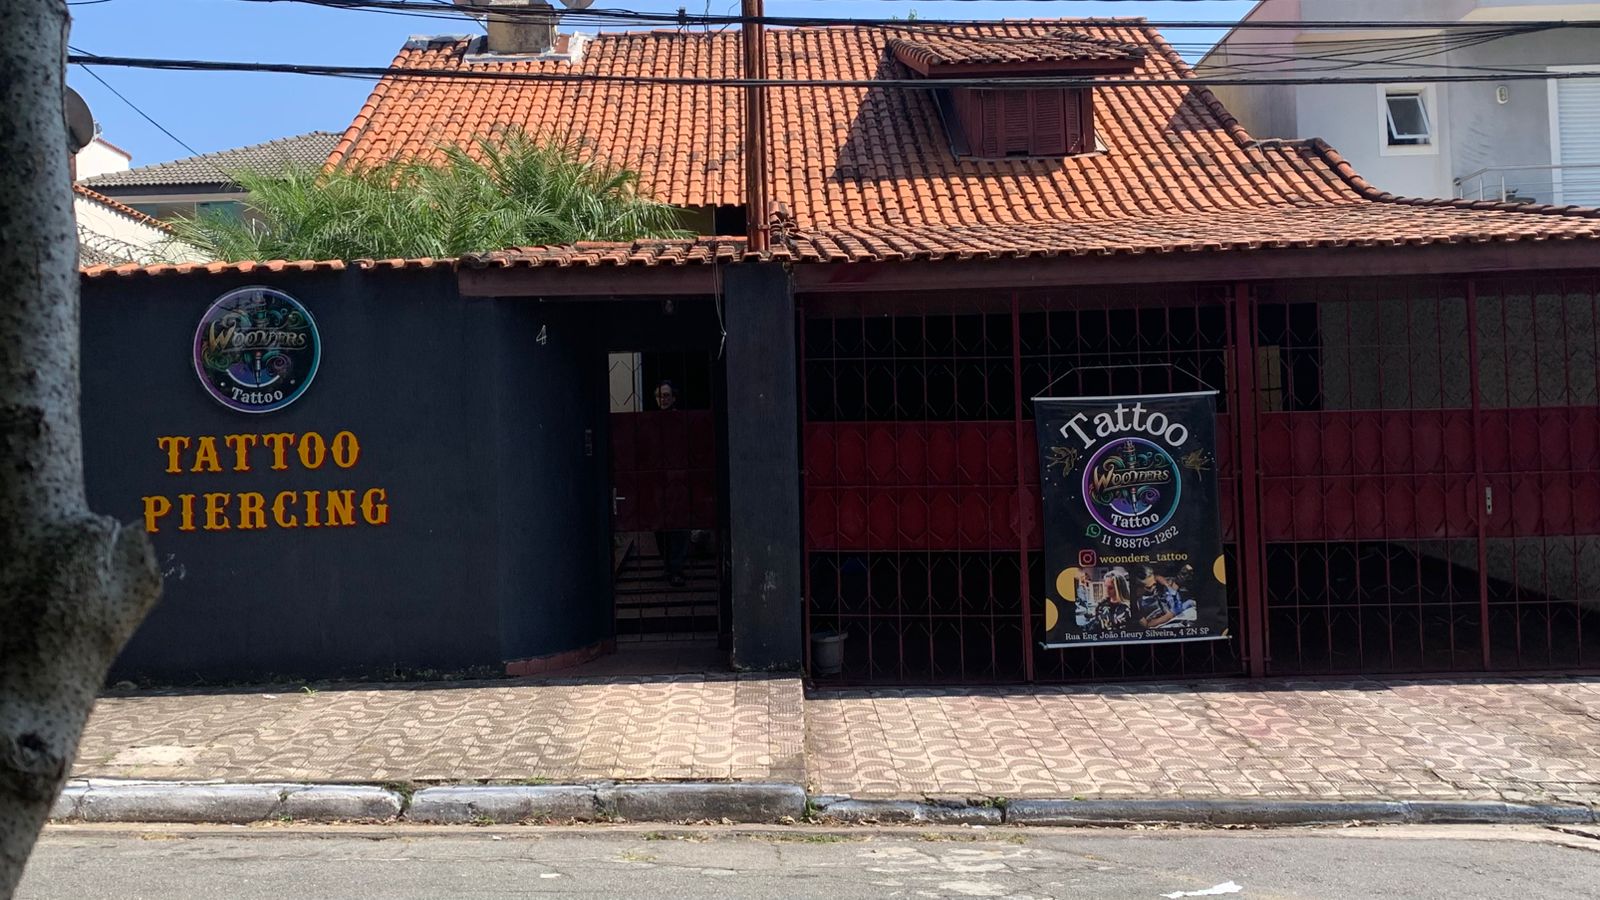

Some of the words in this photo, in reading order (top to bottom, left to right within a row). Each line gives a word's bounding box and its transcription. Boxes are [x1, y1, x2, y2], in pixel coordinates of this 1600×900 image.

[536, 325, 547, 345] 4
[231, 386, 283, 404] Tattoo
[1060, 401, 1188, 450] Tattoo
[156, 430, 361, 473] TATTOO
[141, 487, 391, 533] PIERCING
[1110, 513, 1160, 529] Tattoo
[1101, 534, 1112, 546] 11
[1114, 525, 1179, 549] 98876-1262
[1099, 552, 1188, 564] woonders_tattoo
[1065, 632, 1081, 641] Rua
[1082, 631, 1098, 641] Eng
[1100, 630, 1119, 640] João
[1120, 629, 1144, 640] fleury
[1145, 628, 1177, 638] Silveira,
[1178, 628, 1184, 637] 4
[1186, 627, 1198, 636] ZN
[1199, 626, 1210, 636] SP
